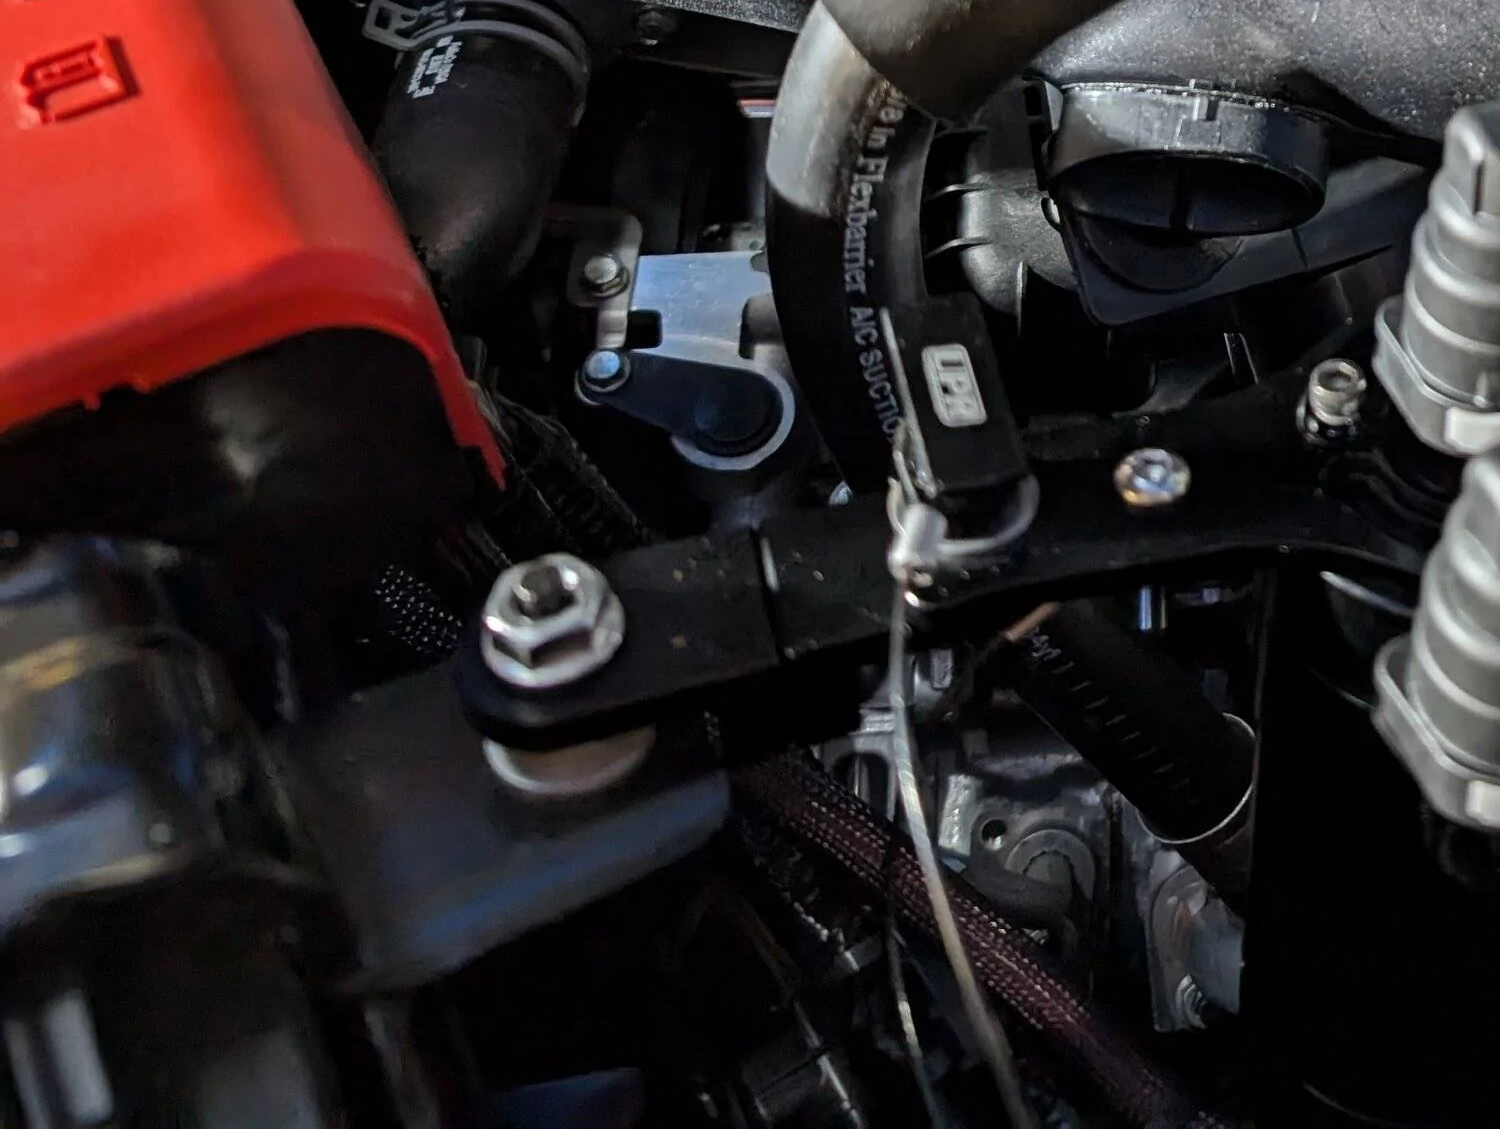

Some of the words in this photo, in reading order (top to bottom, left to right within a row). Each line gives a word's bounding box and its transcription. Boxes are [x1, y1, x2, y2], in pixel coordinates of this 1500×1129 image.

[843, 152, 887, 297] Flexbarrier
[850, 305, 878, 352] A/C
[858, 346, 905, 442] SUCTIO
